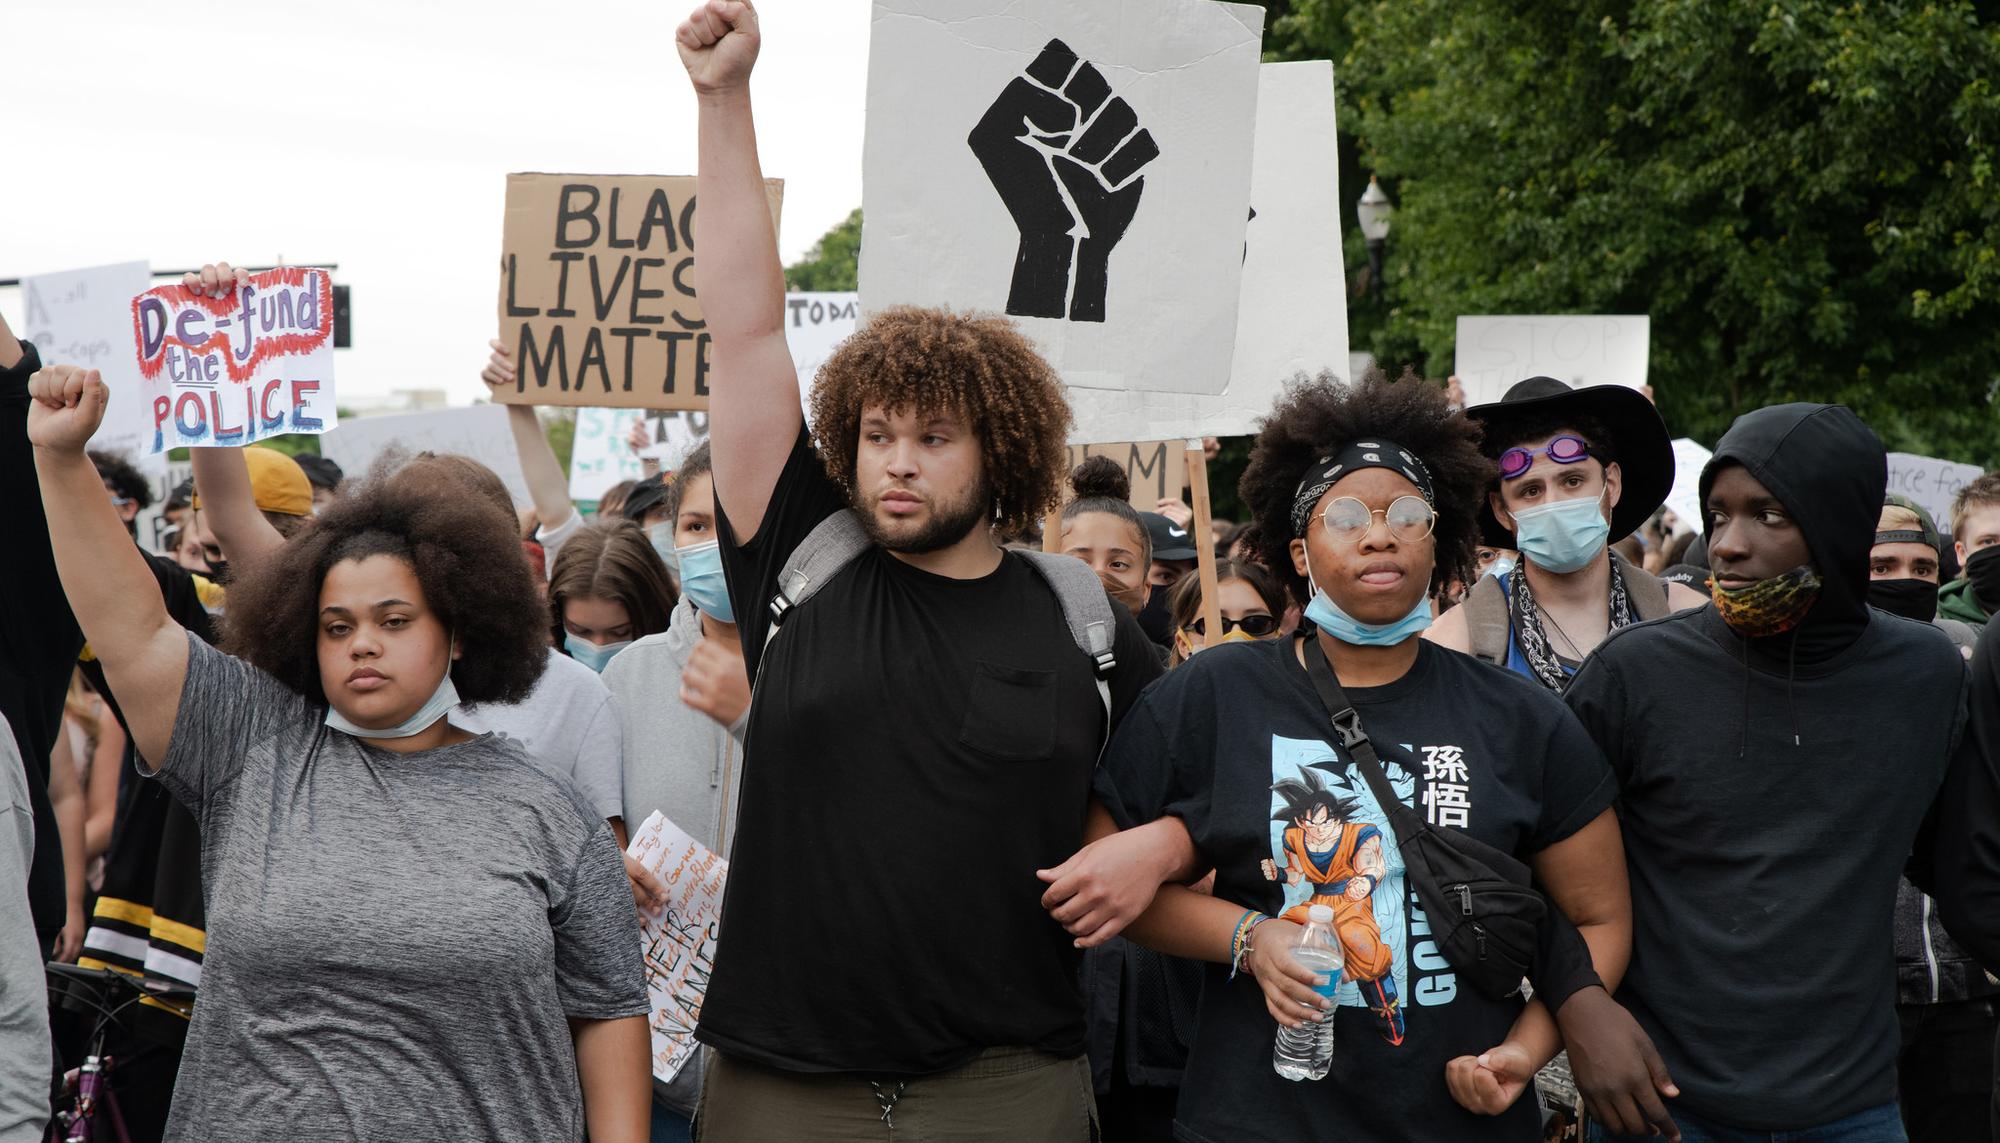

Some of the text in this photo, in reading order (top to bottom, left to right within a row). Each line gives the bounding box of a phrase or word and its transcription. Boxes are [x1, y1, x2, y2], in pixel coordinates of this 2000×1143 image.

[507, 252, 706, 330] LIVES
[788, 299, 858, 328] TODA
[139, 272, 319, 361] De-fund
[166, 347, 219, 382] the
[1478, 319, 1621, 367] STOP
[152, 379, 322, 453] POLICE
[1887, 465, 1967, 496] tice fo
[1421, 745, 1471, 829] 孫悟
[636, 816, 664, 849] Taylor
[665, 841, 695, 885] Garner
[1410, 883, 1457, 1007] GO
